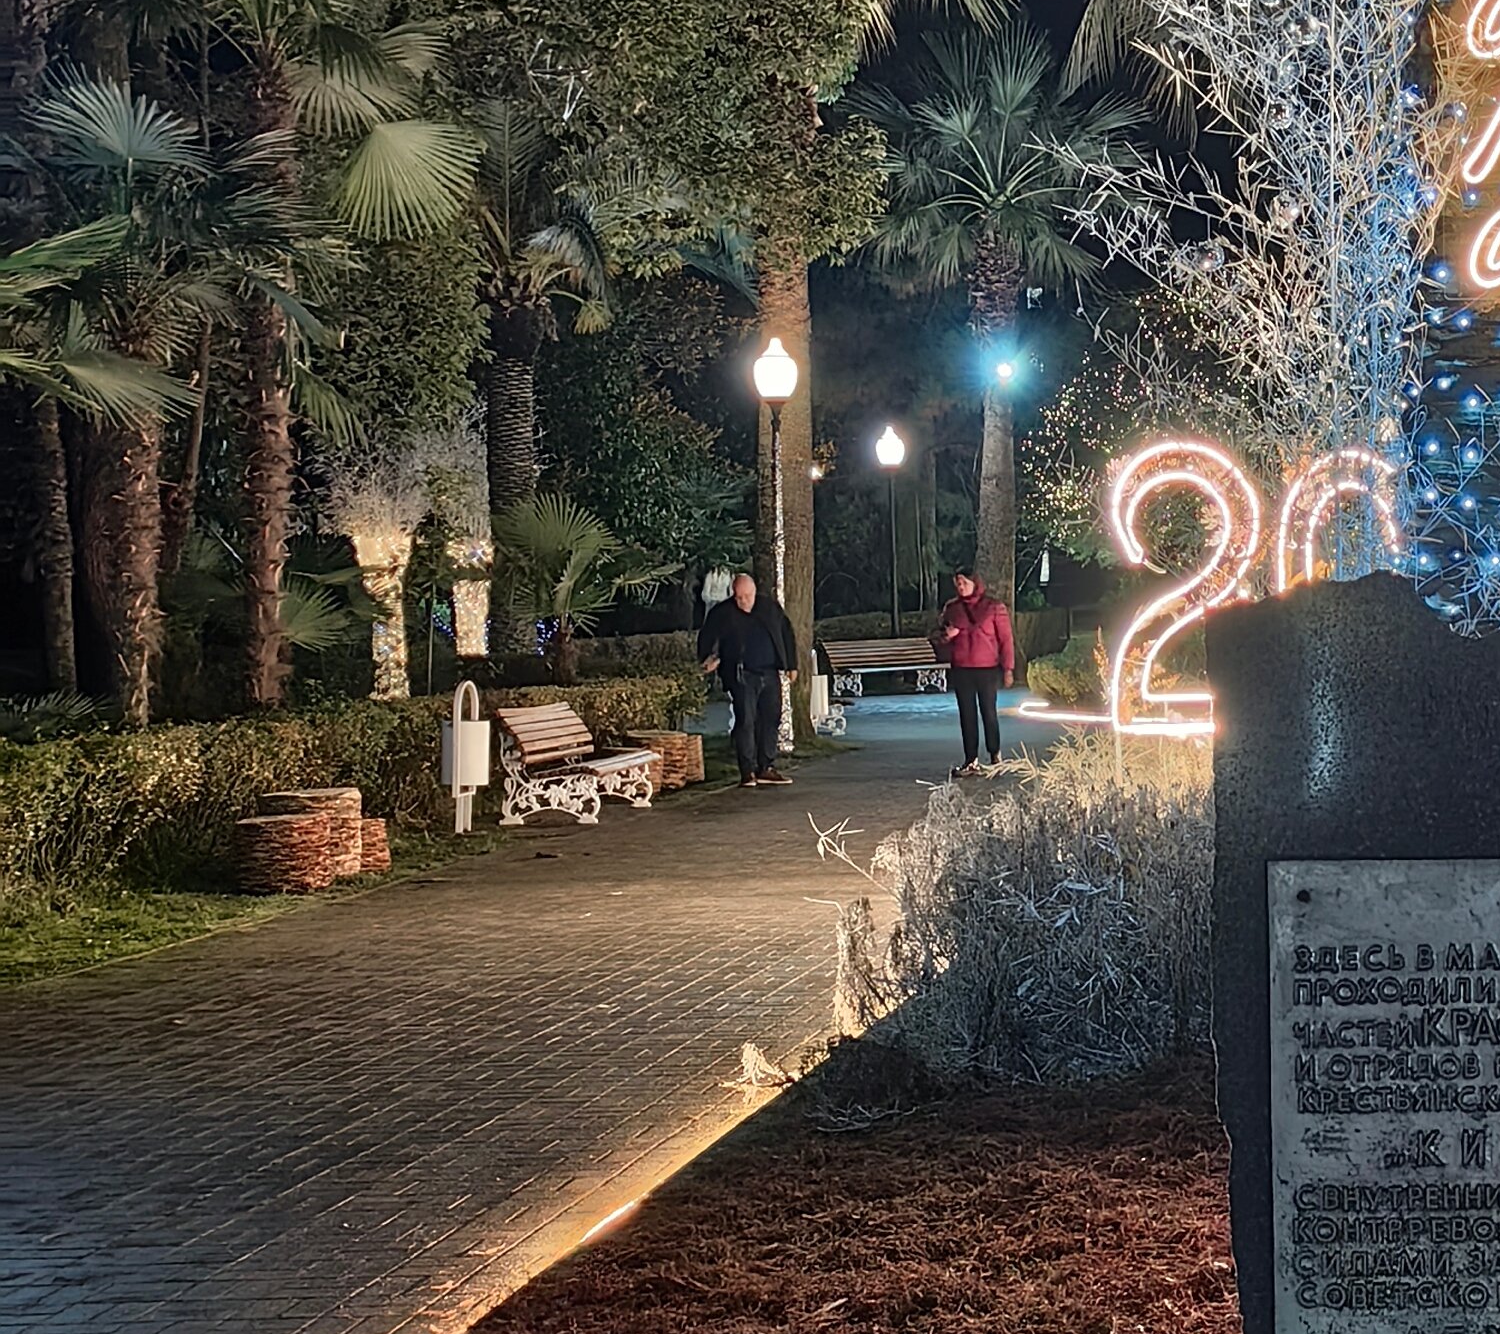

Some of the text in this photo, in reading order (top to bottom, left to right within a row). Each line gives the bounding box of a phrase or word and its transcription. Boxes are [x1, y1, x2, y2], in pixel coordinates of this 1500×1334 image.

[1293, 944, 1405, 973] ЗДЕСЬ
[1416, 944, 1434, 971] В
[1293, 977, 1497, 1005] ПРОХОДИЛИ
[1293, 1013, 1414, 1049] ЧАСТЕЙ
[1294, 1054, 1315, 1082] И
[1325, 1053, 1480, 1082] ОТРЯДОВ
[1294, 1249, 1452, 1276] СИЛАМИ
